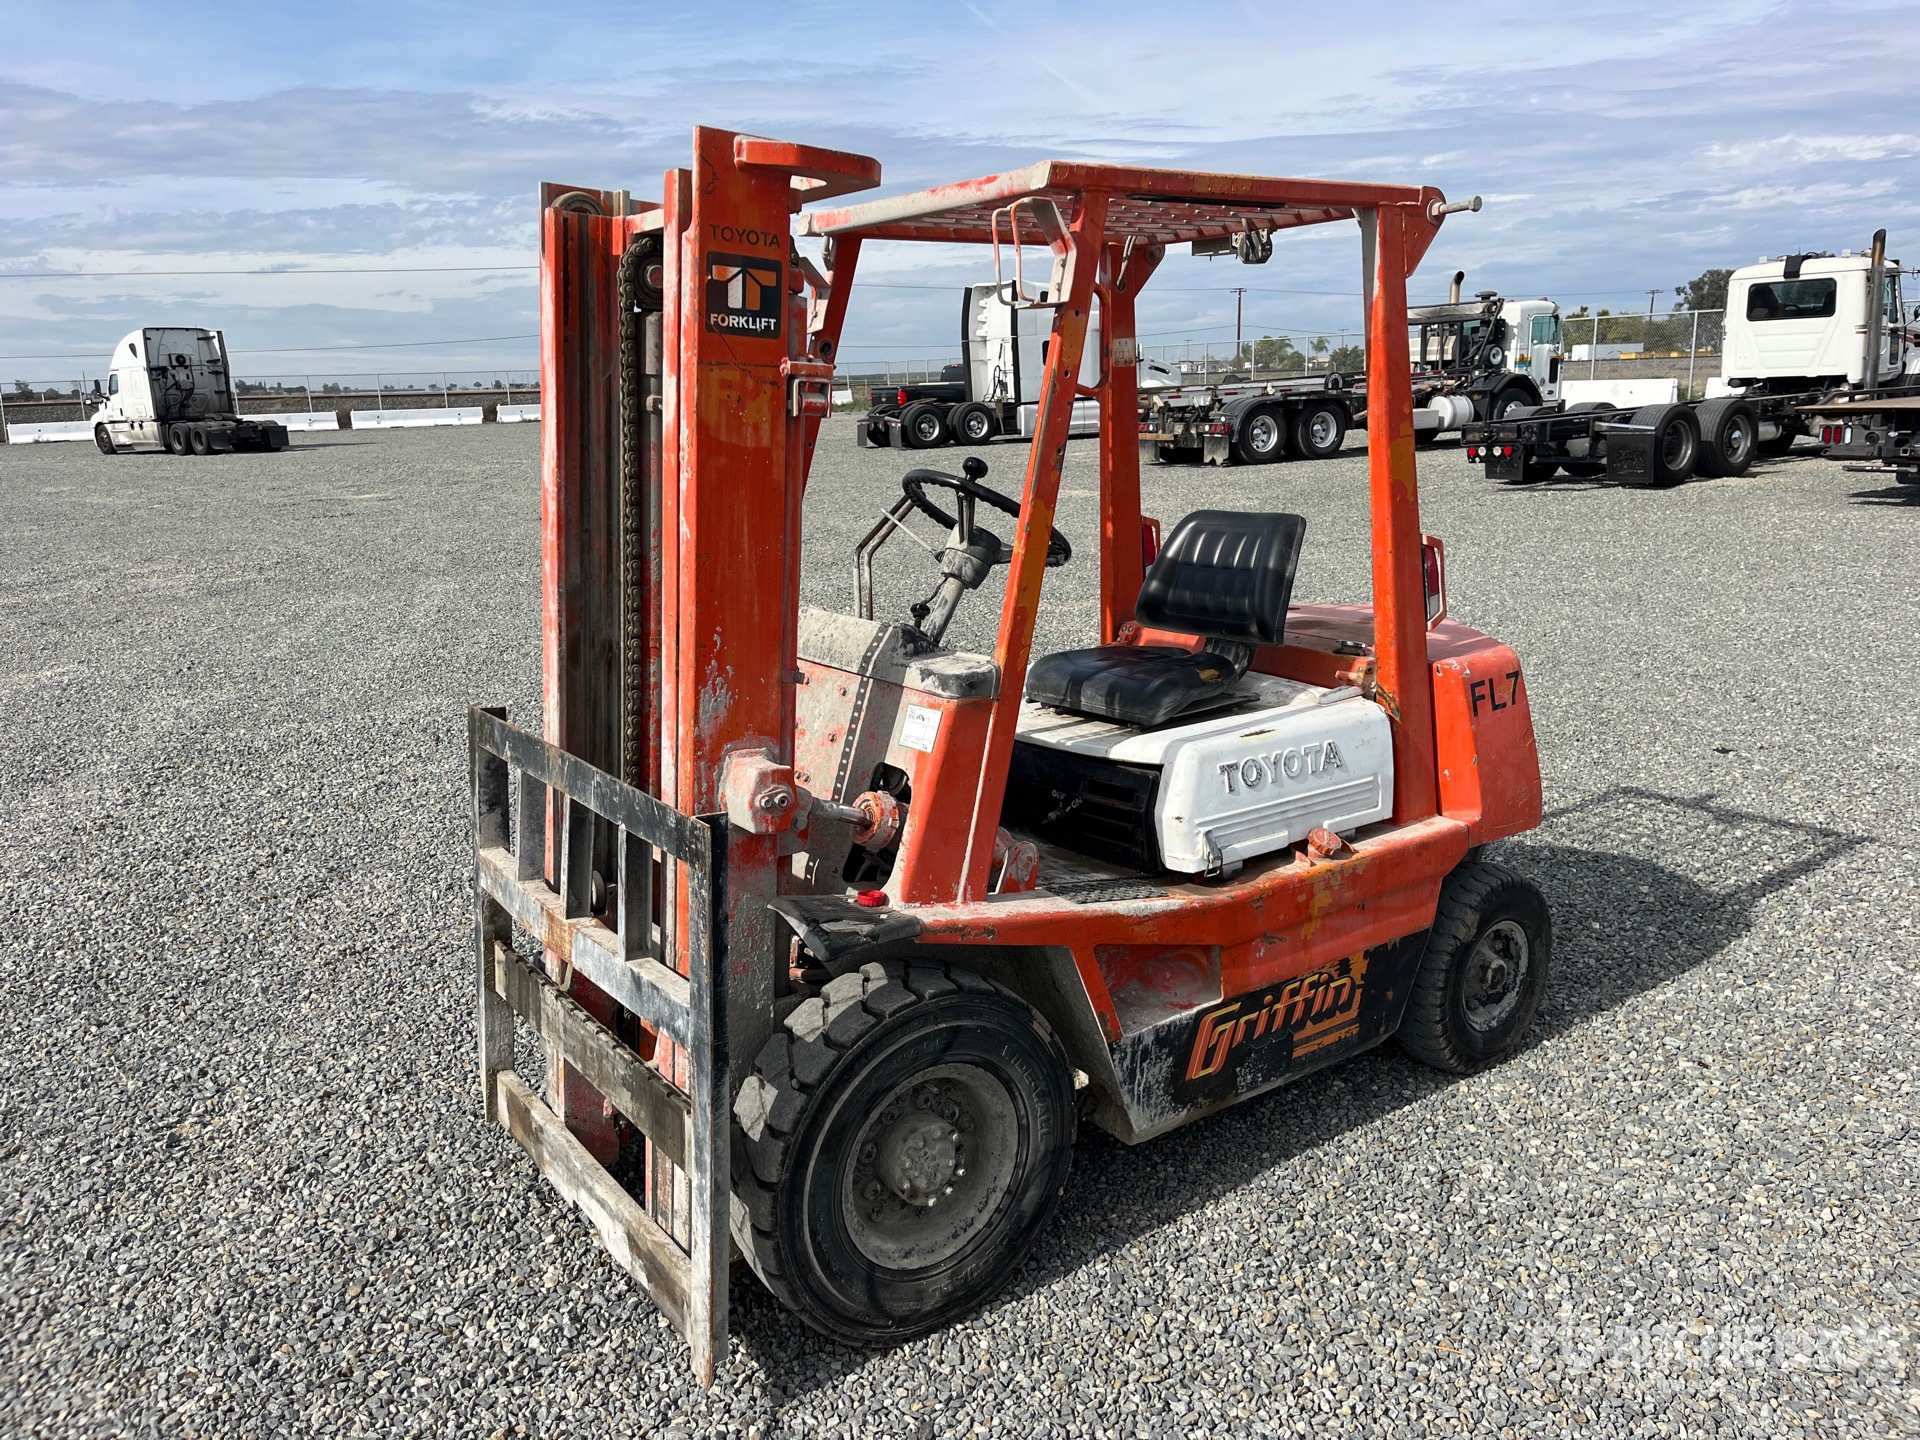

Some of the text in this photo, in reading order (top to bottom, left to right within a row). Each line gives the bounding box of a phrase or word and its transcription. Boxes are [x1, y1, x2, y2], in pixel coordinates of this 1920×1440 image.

[709, 224, 781, 249] TOYOTA
[710, 313, 777, 332] FORKLIFT
[1470, 670, 1519, 718] FL7
[1217, 740, 1342, 794] TOYOTA
[1185, 973, 1352, 1082] Griffin
